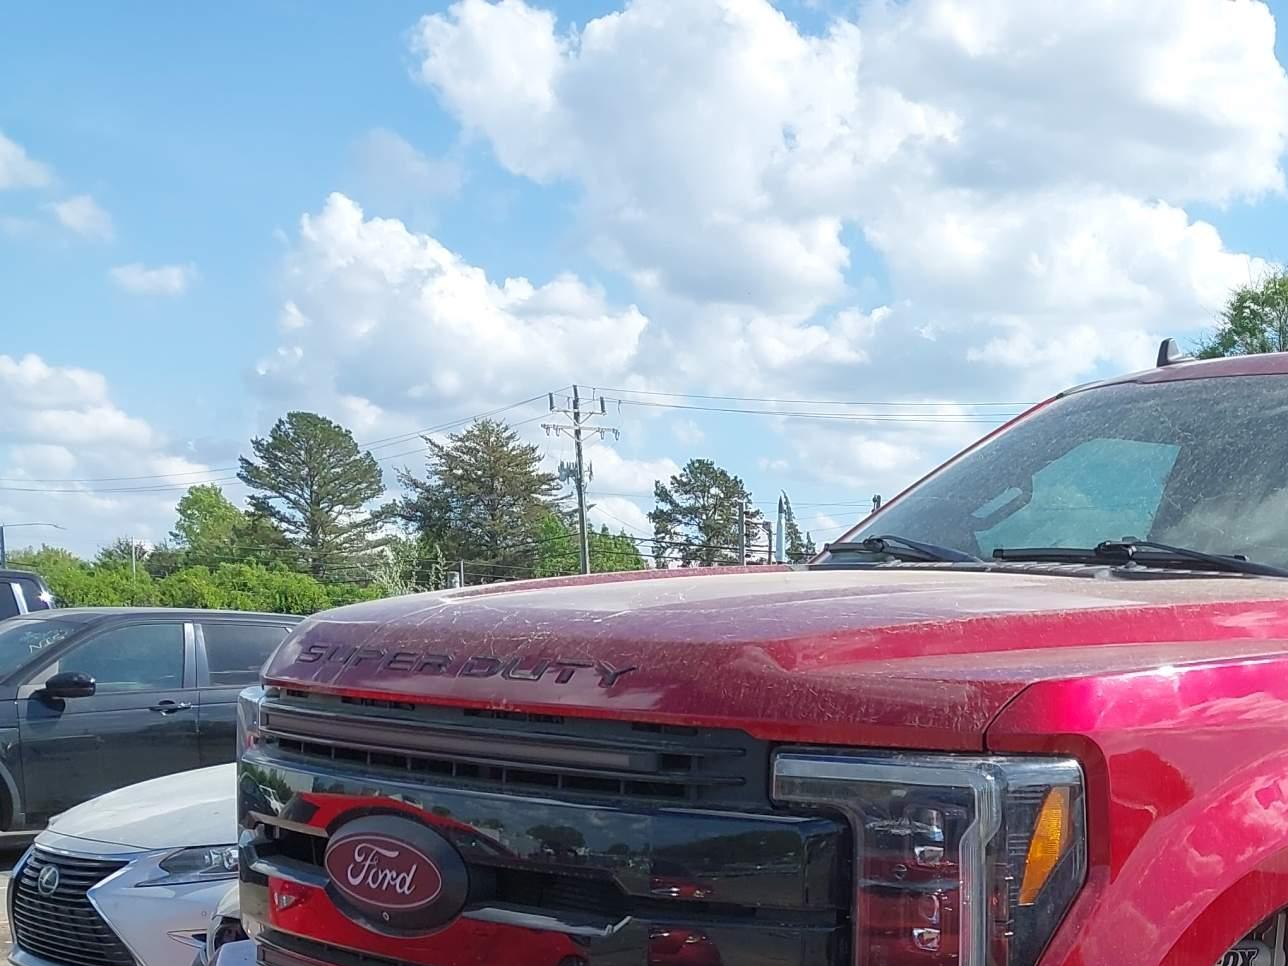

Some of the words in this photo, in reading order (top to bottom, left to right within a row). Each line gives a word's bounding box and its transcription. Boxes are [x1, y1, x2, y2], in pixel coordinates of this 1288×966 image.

[297, 643, 457, 675] SUPER
[458, 656, 642, 689] DUTY
[345, 842, 417, 897] Ford
